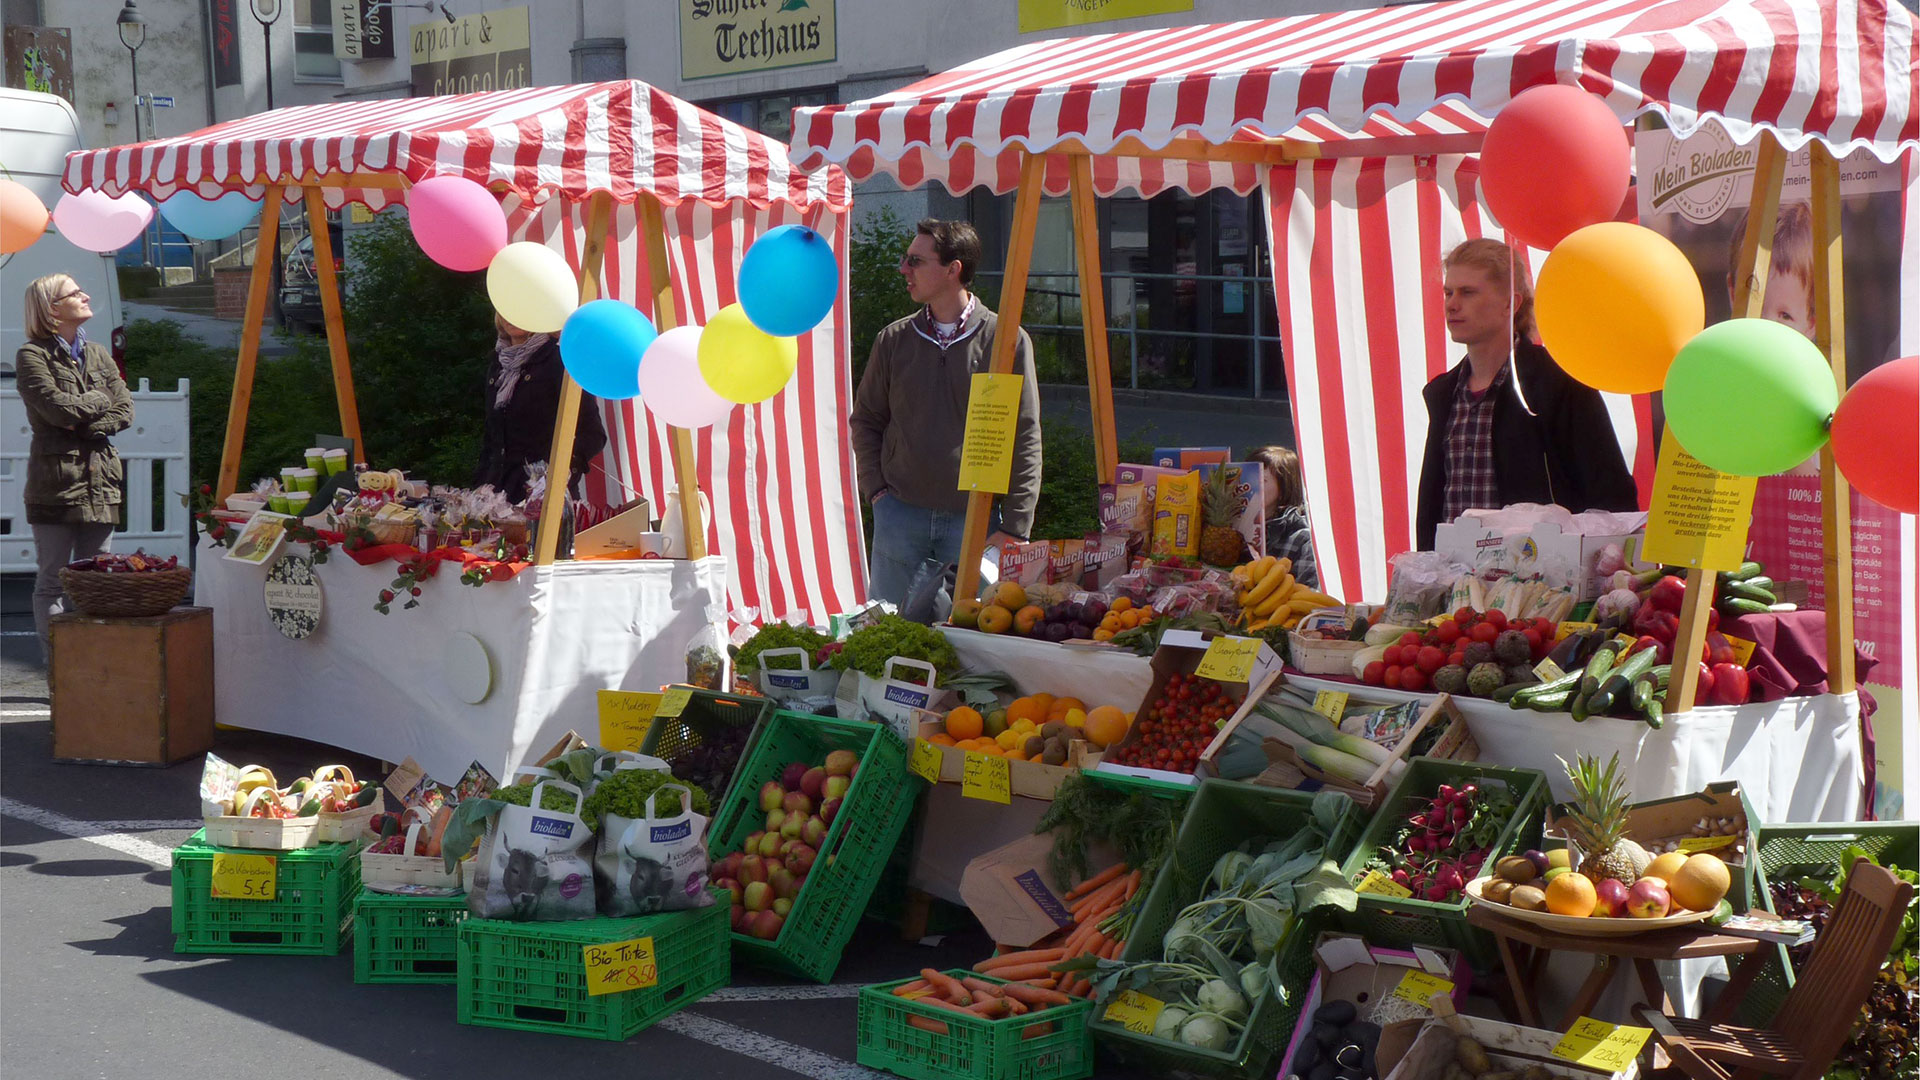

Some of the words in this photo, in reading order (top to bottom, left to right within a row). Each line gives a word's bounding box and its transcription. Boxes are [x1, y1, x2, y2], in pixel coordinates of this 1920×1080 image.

[341, 3, 363, 55] apart
[415, 20, 470, 64] apart
[479, 15, 492, 44] &
[714, 16, 821, 63] Teehaus
[1654, 164, 1686, 196] Mein
[1690, 149, 1752, 177] Bioladen
[1672, 485, 1702, 494] Bestellen
[1702, 487, 1712, 495] Sie
[1788, 488, 1812, 503] 100%
[1680, 503, 1708, 511] erhalten
[1084, 541, 1126, 565] Krunchy
[887, 688, 922, 706] bioladen
[533, 820, 568, 836] bioladen
[653, 826, 687, 841] bioladen
[586, 944, 650, 967] Bio-Tüte
